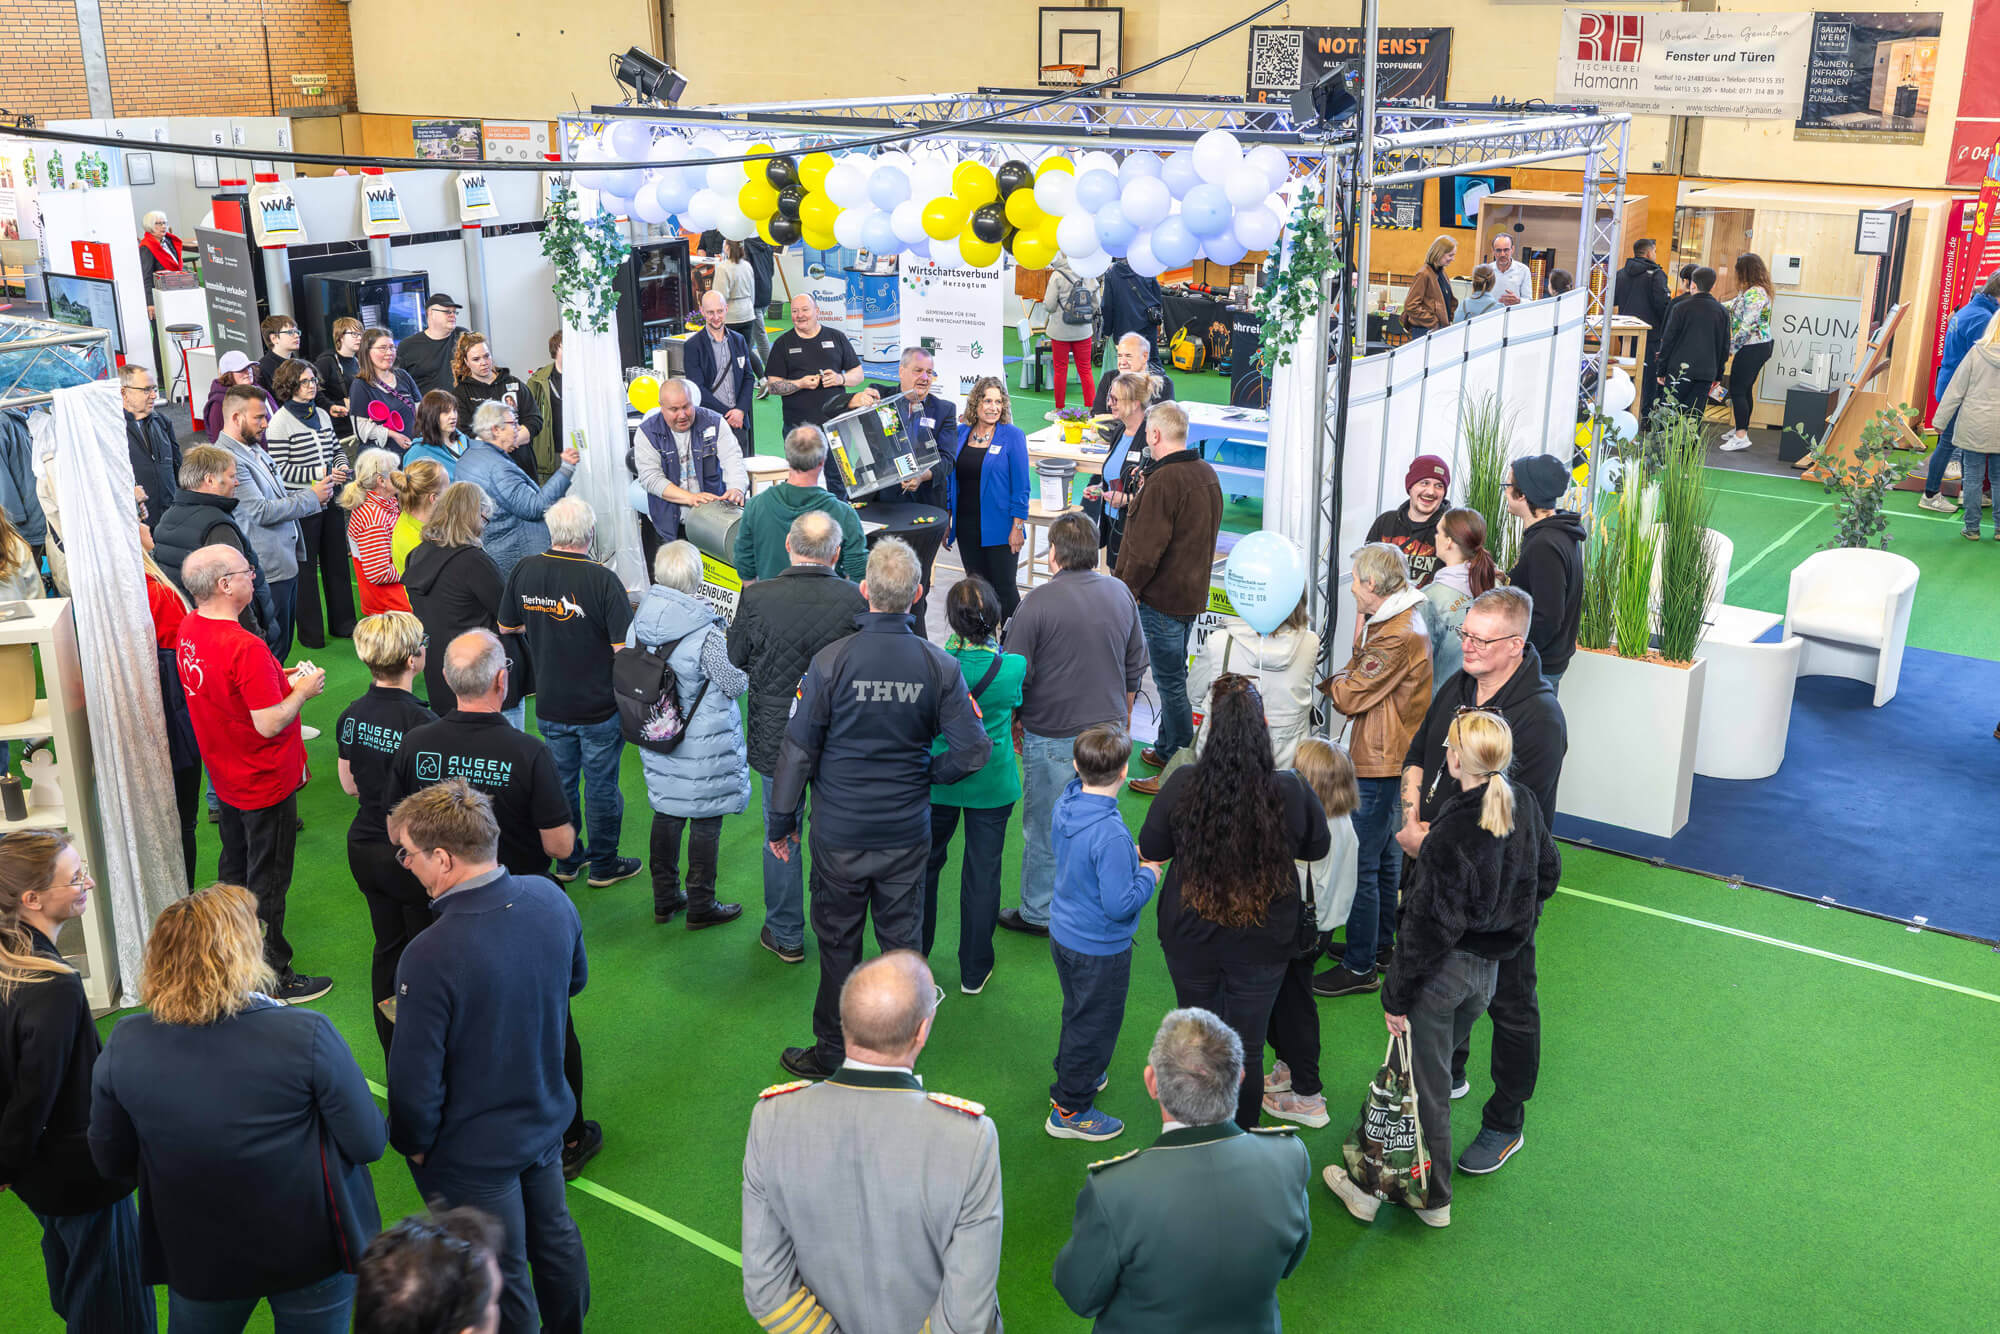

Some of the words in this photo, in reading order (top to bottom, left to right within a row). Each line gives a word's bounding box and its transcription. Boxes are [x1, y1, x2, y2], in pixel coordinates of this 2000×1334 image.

[1700, 26, 1734, 41] Leben
[1820, 26, 1847, 34] SAUNA
[1577, 13, 1644, 62] RH
[1665, 50, 1710, 62] Fenster
[1713, 51, 1737, 62] und
[1739, 51, 1776, 63] Türen
[1576, 63, 1640, 72] TISCHLEREI
[1813, 60, 1848, 68] SAUNEN
[1812, 69, 1857, 77] INFRAROT-
[1574, 72, 1638, 90] Hamann
[1811, 77, 1849, 86] KABINEN
[1808, 94, 1849, 104] ZUHAUSE
[1685, 104, 1782, 115] www.tischlerei-ralf-hamann.de
[908, 265, 999, 280] Wirtschaftsverbund
[942, 280, 987, 289] Herzogtum
[521, 594, 557, 607] Tierheim
[852, 680, 924, 704] THW
[358, 722, 403, 742] AUGEN
[358, 732, 401, 750] ZUHAUSE
[448, 755, 512, 773] AUGEN
[447, 766, 511, 782] ZUHAUSE
